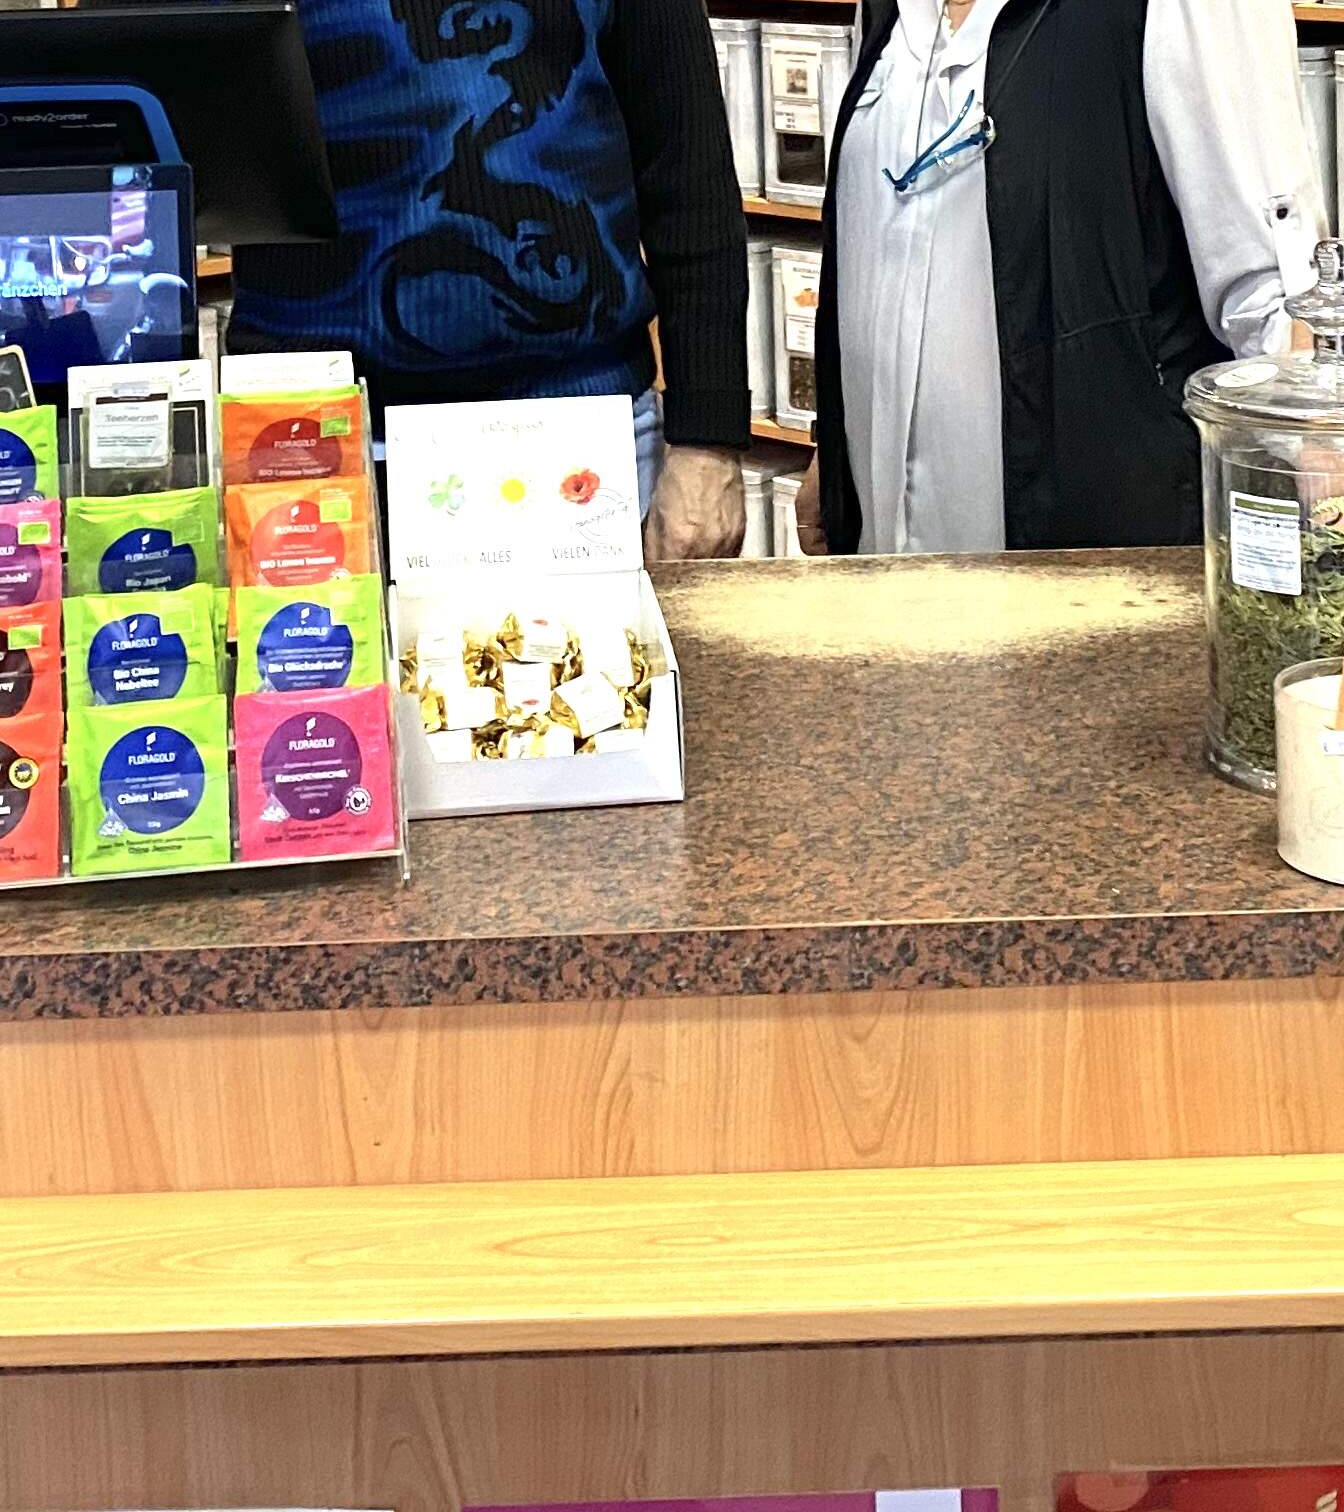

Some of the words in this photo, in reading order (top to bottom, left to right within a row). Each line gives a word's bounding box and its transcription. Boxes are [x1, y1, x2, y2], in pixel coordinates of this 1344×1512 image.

[12, 112, 89, 123] ready2order
[274, 439, 317, 449] FLORAGOLD
[274, 524, 318, 535] FLORAGOLD
[124, 549, 170, 561] FLORAGOLD
[480, 550, 512, 563] ALLES
[552, 546, 590, 560] VIELEN
[406, 554, 430, 570] VIEL
[283, 626, 329, 638] FLORAGOLD
[112, 638, 158, 651] FLORAGOLD
[113, 669, 130, 680] Bio
[131, 665, 160, 678] China
[288, 738, 336, 752] FLORAGOLD
[128, 753, 176, 765] FLORAGOLD
[117, 792, 150, 805] China
[151, 788, 189, 802] Jasmin
